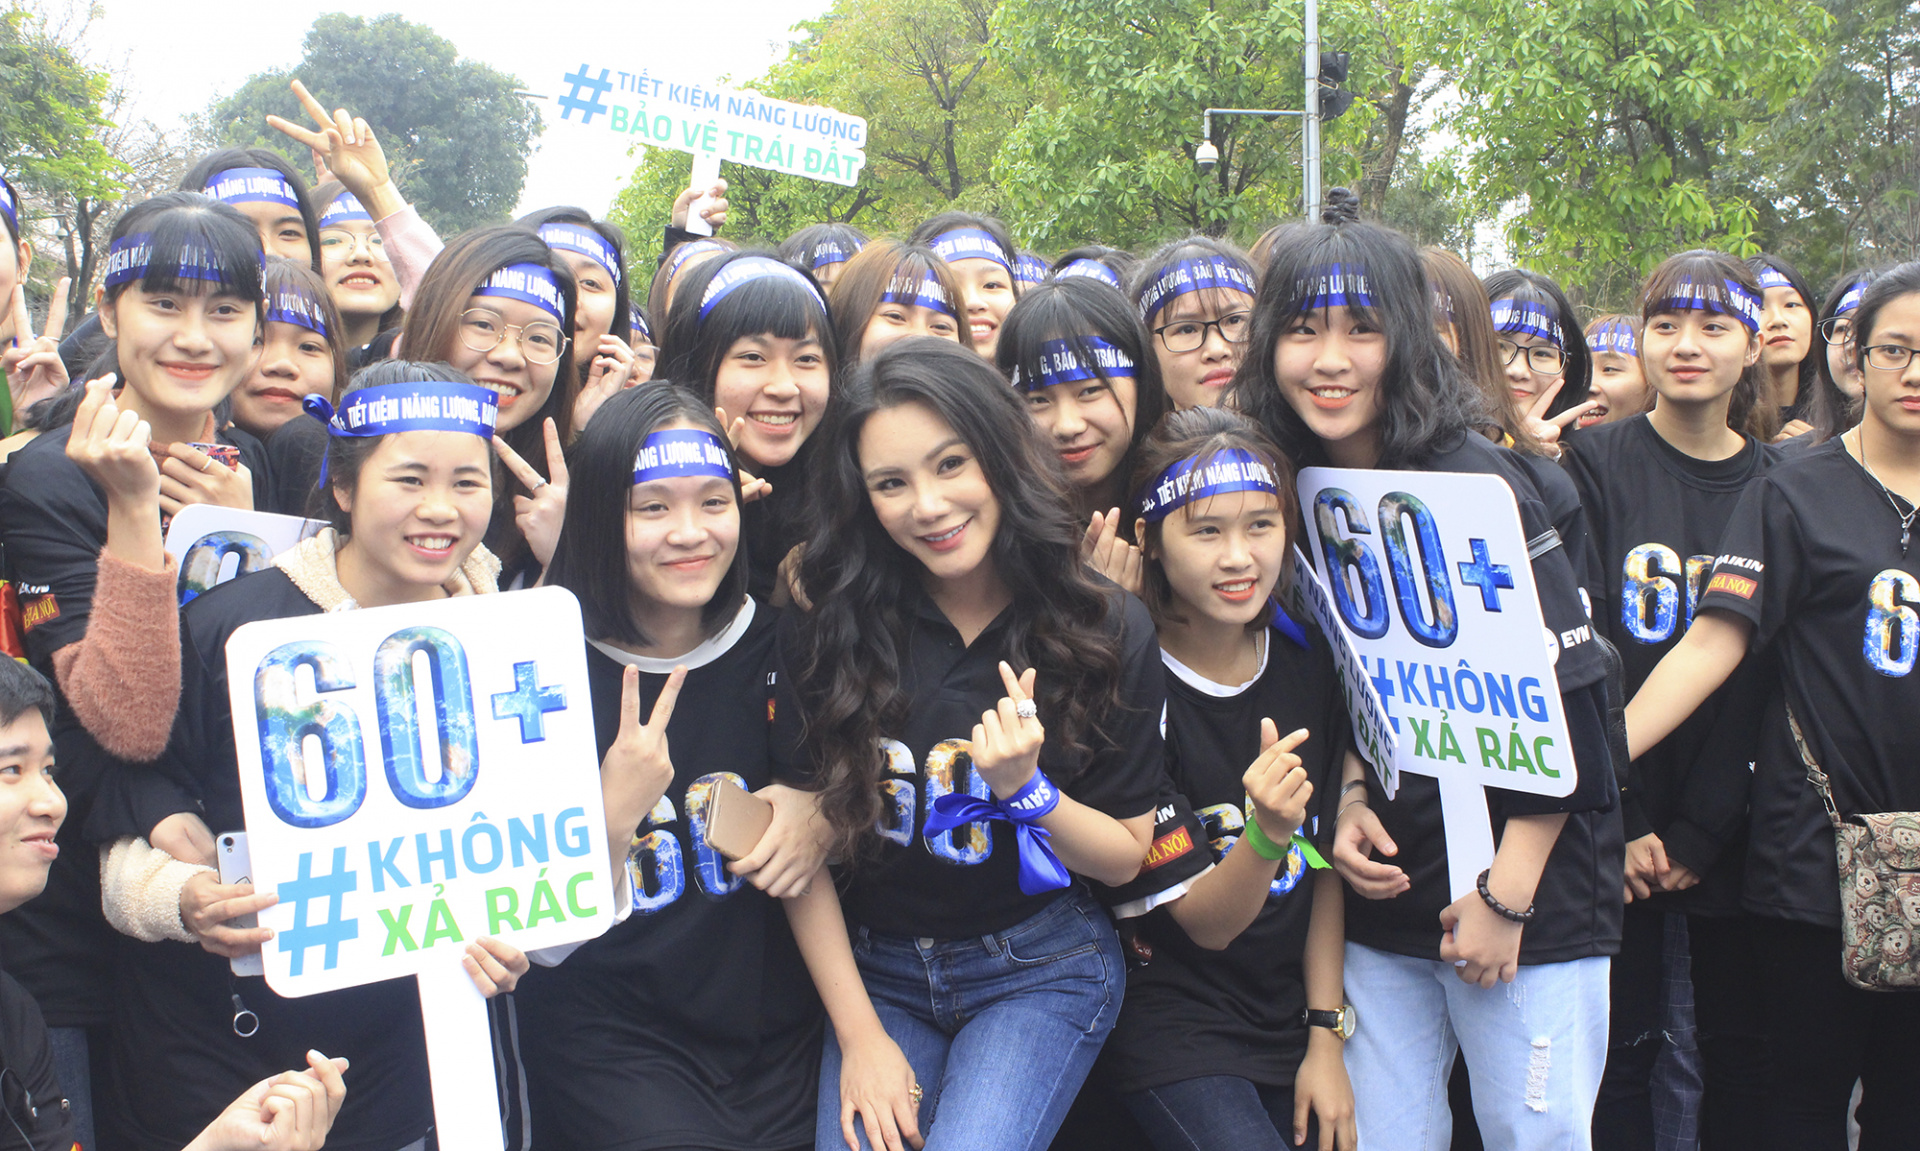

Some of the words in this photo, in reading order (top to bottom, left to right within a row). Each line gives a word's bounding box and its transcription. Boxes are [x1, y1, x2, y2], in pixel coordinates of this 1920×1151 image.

[617, 69, 663, 98] TIẾT
[668, 83, 720, 112] KIỆM
[727, 96, 786, 126] NĂNG
[792, 109, 861, 142] LƯỢNG
[611, 101, 672, 142] BẢO
[682, 120, 719, 159] VỆ
[726, 130, 795, 168] TRÁI
[803, 140, 859, 181] ĐẤT
[217, 178, 246, 200] NĂNG
[131, 242, 153, 268] NĂN
[1193, 259, 1214, 280] BẢO
[1213, 261, 1229, 282] VỆ
[1053, 343, 1078, 373] BẢO
[1094, 344, 1117, 368] TRÁI
[347, 397, 367, 429] TIẾT
[368, 395, 399, 426] KIỆM
[402, 392, 440, 419] NĂNG
[442, 395, 481, 425] LƯỢNG,
[659, 440, 705, 469] LƯỢNG,
[1157, 475, 1177, 507] TIẾT
[1205, 460, 1241, 486] NĂNG
[1313, 487, 1514, 648] 60+
[1726, 578, 1752, 595] NỘI
[1560, 624, 1591, 649] EVN
[1308, 575, 1347, 659] NĂNG
[1350, 655, 1393, 759] LƯỢNG
[1396, 659, 1550, 723] KHÔNG
[253, 626, 568, 829] 60+
[1358, 706, 1393, 790] ĐẤT
[1408, 709, 1467, 764] XẢ
[1476, 722, 1561, 779] RÁC
[367, 807, 592, 893] KHÔNG
[1160, 832, 1189, 858] NỘI
[376, 883, 464, 957] XẢ
[485, 867, 598, 936] RÁC
